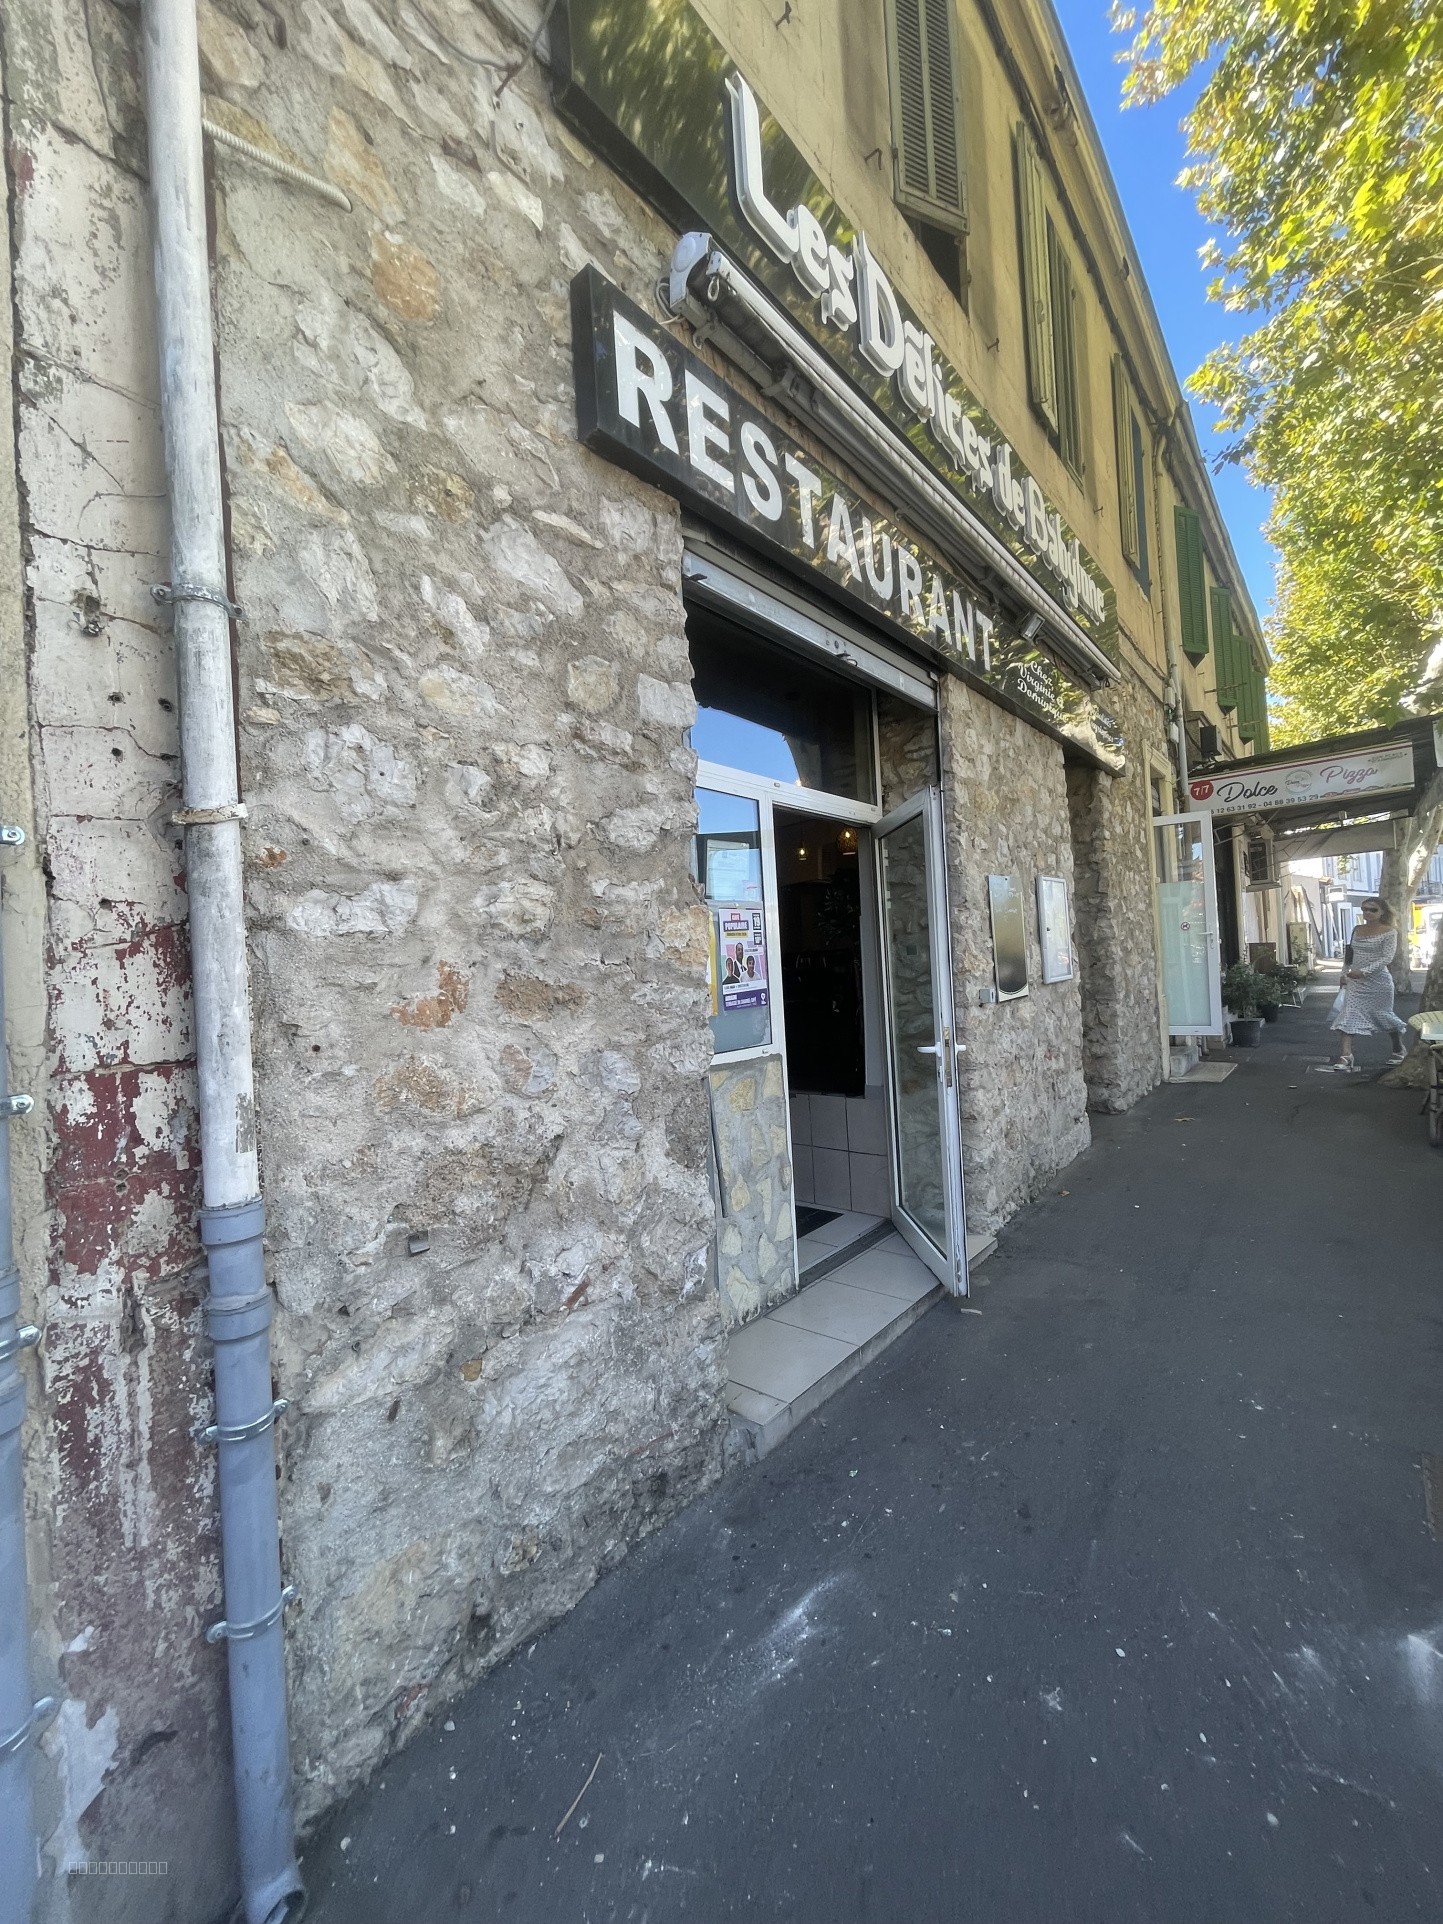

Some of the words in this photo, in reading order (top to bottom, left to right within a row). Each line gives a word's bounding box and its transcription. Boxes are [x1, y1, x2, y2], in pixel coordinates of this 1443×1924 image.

[725, 70, 857, 332] Les
[990, 443, 1026, 531] de
[613, 309, 994, 672] RESTAURANT
[1017, 662, 1056, 703] Virginie
[1030, 660, 1053, 686] Chez
[1319, 765, 1378, 785] Pizza
[1193, 784, 1210, 797] 7/7
[1216, 781, 1278, 802] Dolce
